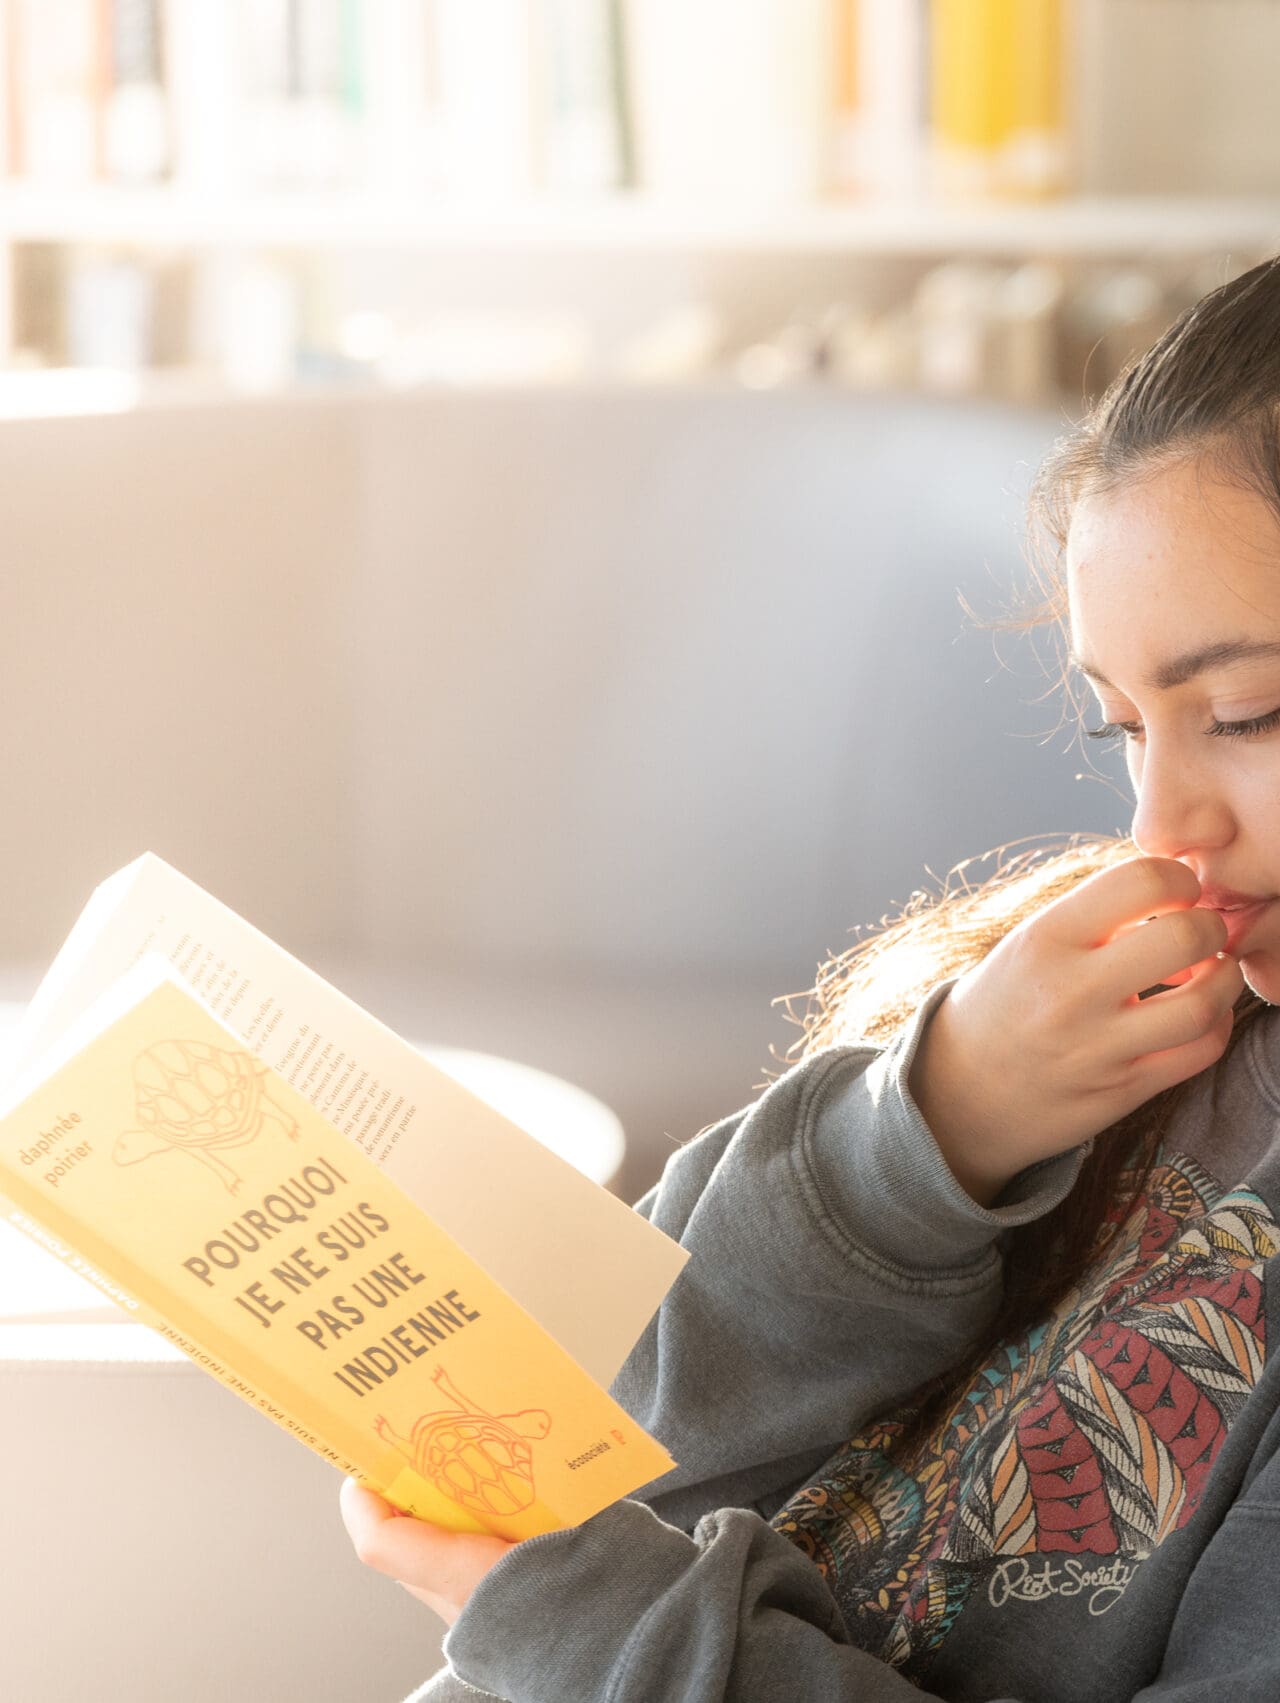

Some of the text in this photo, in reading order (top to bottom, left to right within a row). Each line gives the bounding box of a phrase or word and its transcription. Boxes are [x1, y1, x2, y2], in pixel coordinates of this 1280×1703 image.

[299, 1024, 310, 1037] du
[301, 1042, 334, 1092] ne porte pas
[325, 1071, 351, 1106] Cantons
[347, 1060, 359, 1073] de
[330, 1052, 346, 1072] dans
[19, 1112, 81, 1166] daphnée
[355, 1088, 393, 1144] passage tradi-
[364, 1096, 406, 1156] de romantisme
[379, 1105, 417, 1162] sera en partie
[44, 1141, 93, 1188] poirier
[181, 1156, 349, 1288] POURQUOI
[234, 1202, 390, 1329] JE NE SUIS
[296, 1252, 427, 1351] PAS UNE
[158, 1322, 226, 1378] INDIENNE
[333, 1289, 481, 1398] INDIENNE
[226, 1375, 256, 1399] UNE
[258, 1399, 285, 1420] PAS
[286, 1420, 318, 1444] SUIS
[988, 1558, 1139, 1616] Riot Society
